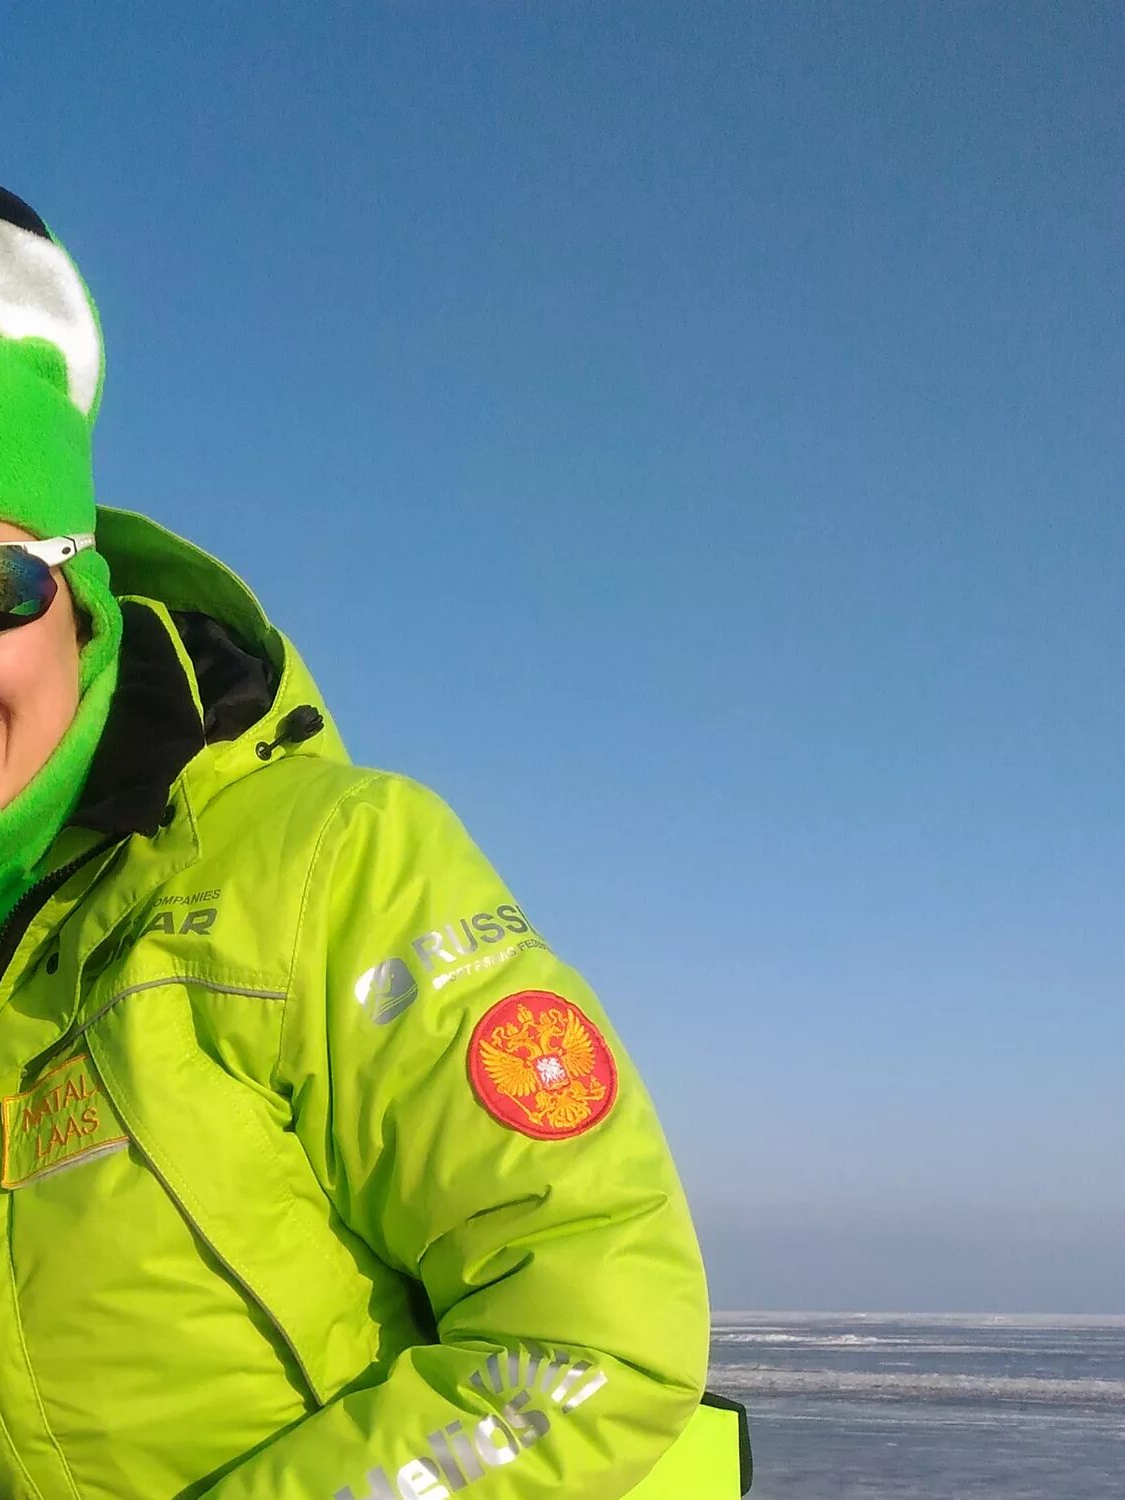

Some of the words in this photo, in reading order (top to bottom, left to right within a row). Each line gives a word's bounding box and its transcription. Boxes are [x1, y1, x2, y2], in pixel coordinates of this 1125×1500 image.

[153, 889, 221, 907] OMPANIES
[139, 907, 218, 935] AR
[21, 1074, 101, 1133] NATAL
[36, 1106, 100, 1159] LAAS
